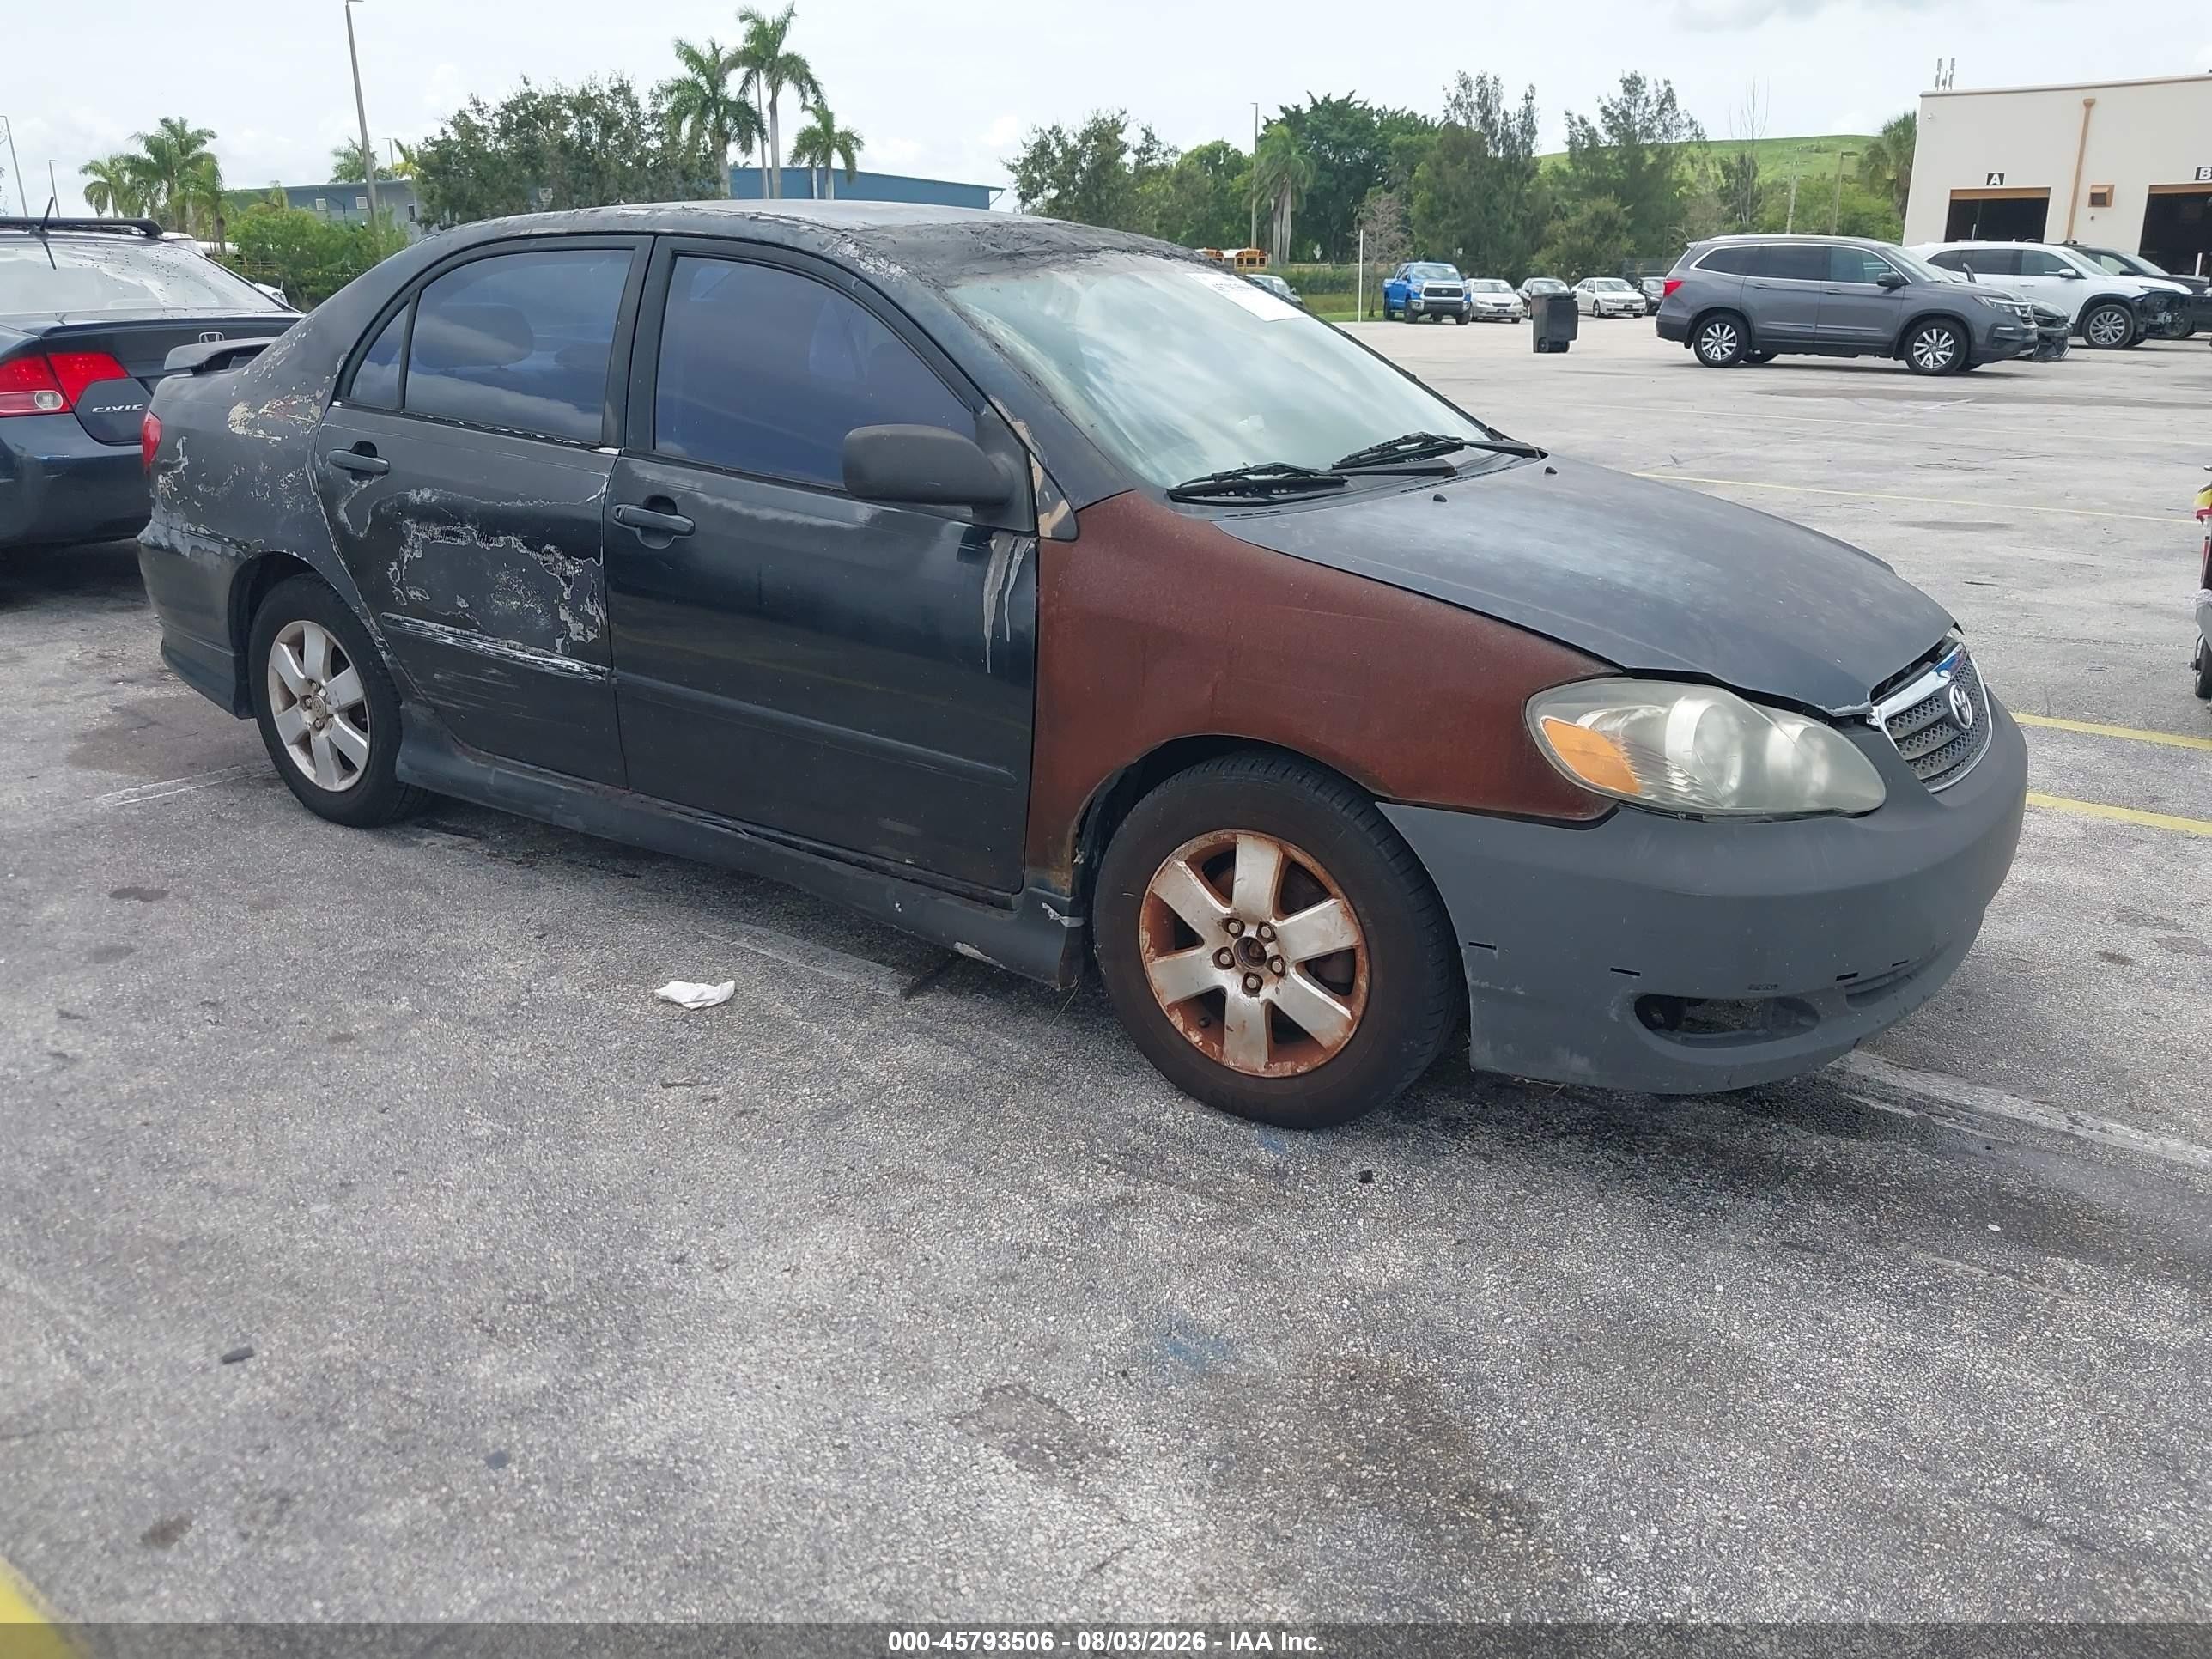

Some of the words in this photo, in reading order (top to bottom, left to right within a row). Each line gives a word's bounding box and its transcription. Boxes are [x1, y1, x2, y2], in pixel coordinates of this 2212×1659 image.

[1989, 173, 2001, 185] A
[2199, 167, 2211, 179] B
[91, 404, 143, 413] CIVIC
